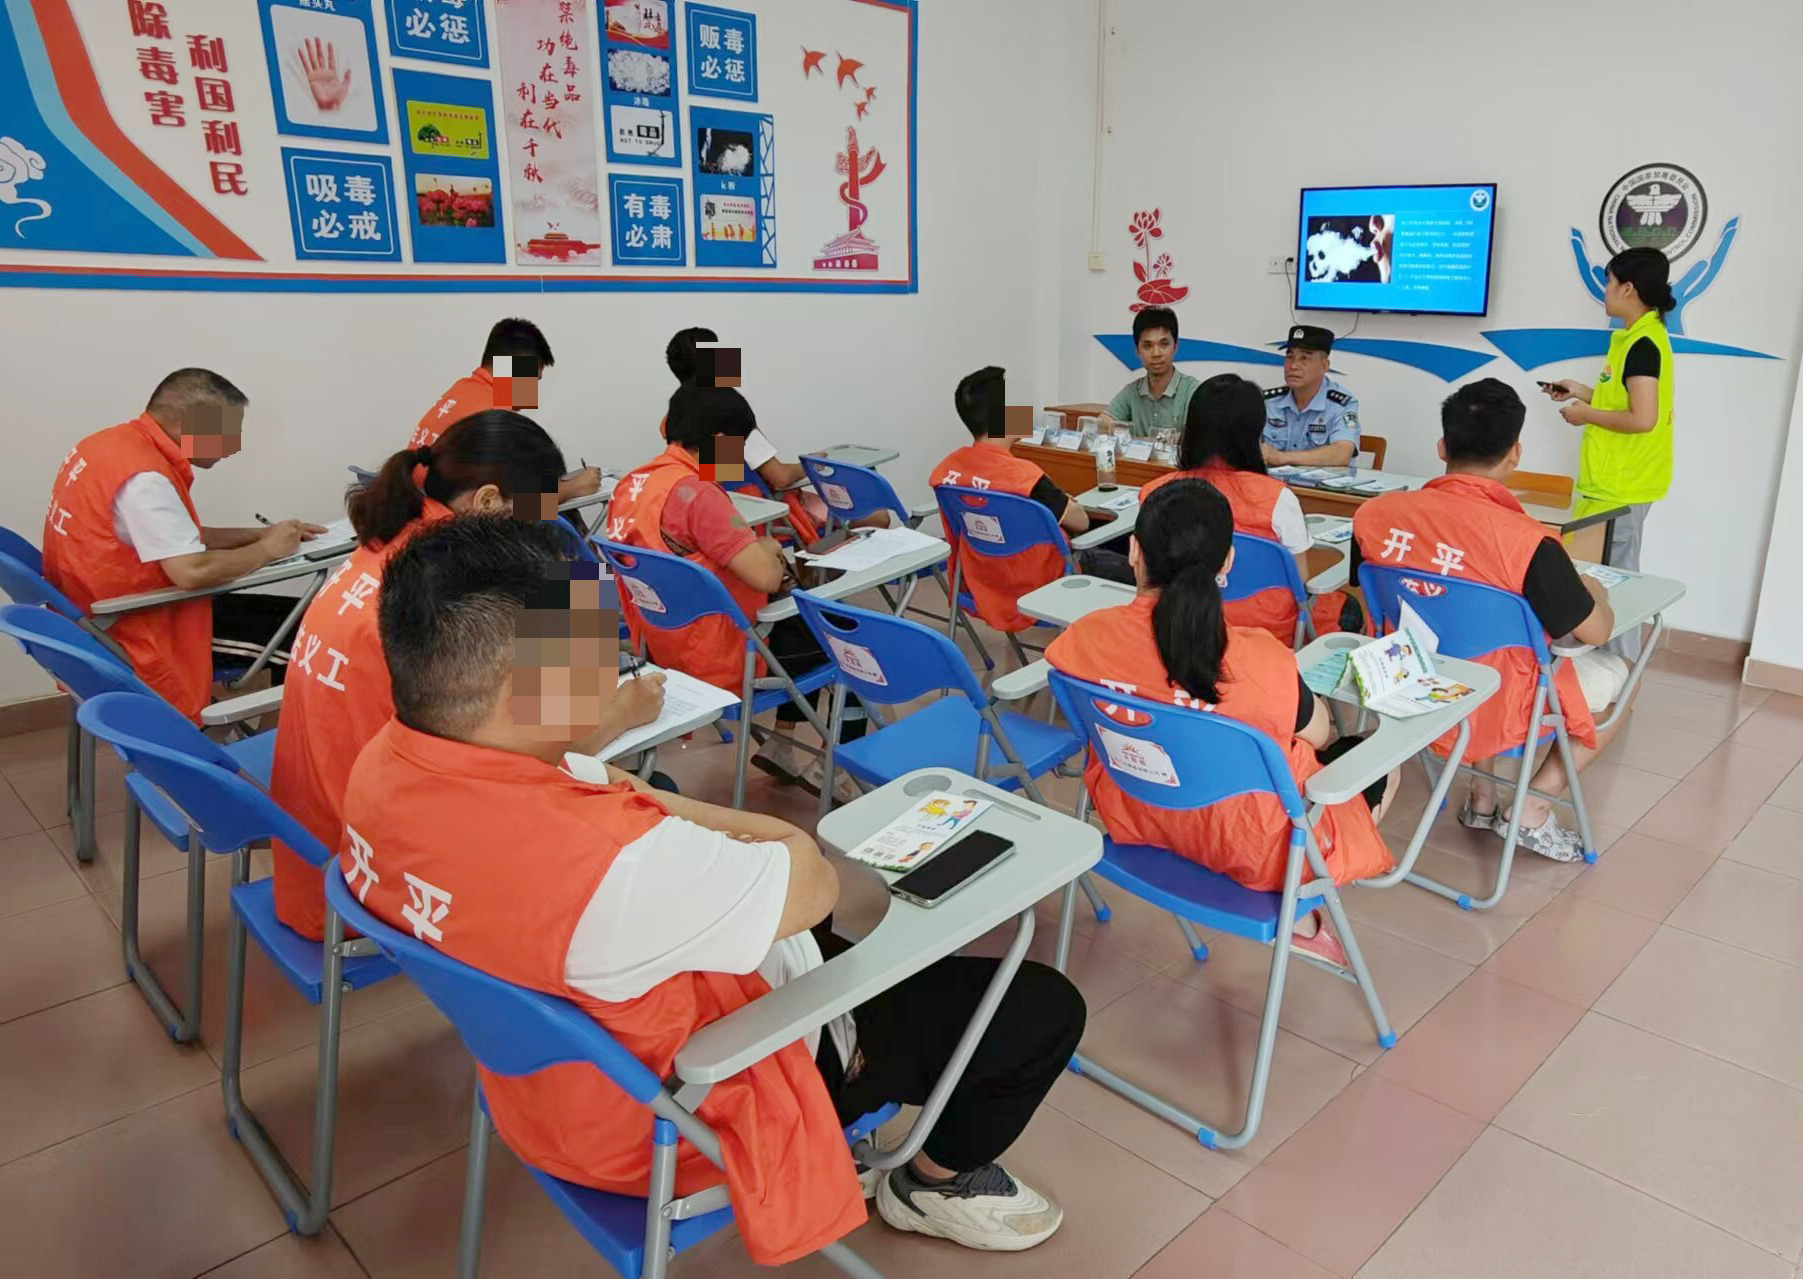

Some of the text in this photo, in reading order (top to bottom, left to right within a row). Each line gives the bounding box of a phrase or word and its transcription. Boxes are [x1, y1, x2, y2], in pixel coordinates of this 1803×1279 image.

[405, 7, 471, 44] 必惩
[699, 24, 745, 54] 贩毒
[127, 0, 186, 127] 除毒害
[558, 1, 581, 102] 禁绝毒品
[700, 54, 746, 82] 必惩
[537, 38, 562, 140] 功在当代
[185, 34, 249, 196] 利国利民
[516, 81, 544, 184] 利在千秋
[305, 174, 377, 205] 吸毒
[623, 193, 672, 219] 有毒
[312, 209, 382, 241] 必戒
[625, 224, 674, 249] 必肃
[1380, 527, 1466, 576] 开平
[345, 823, 453, 943] 开平
